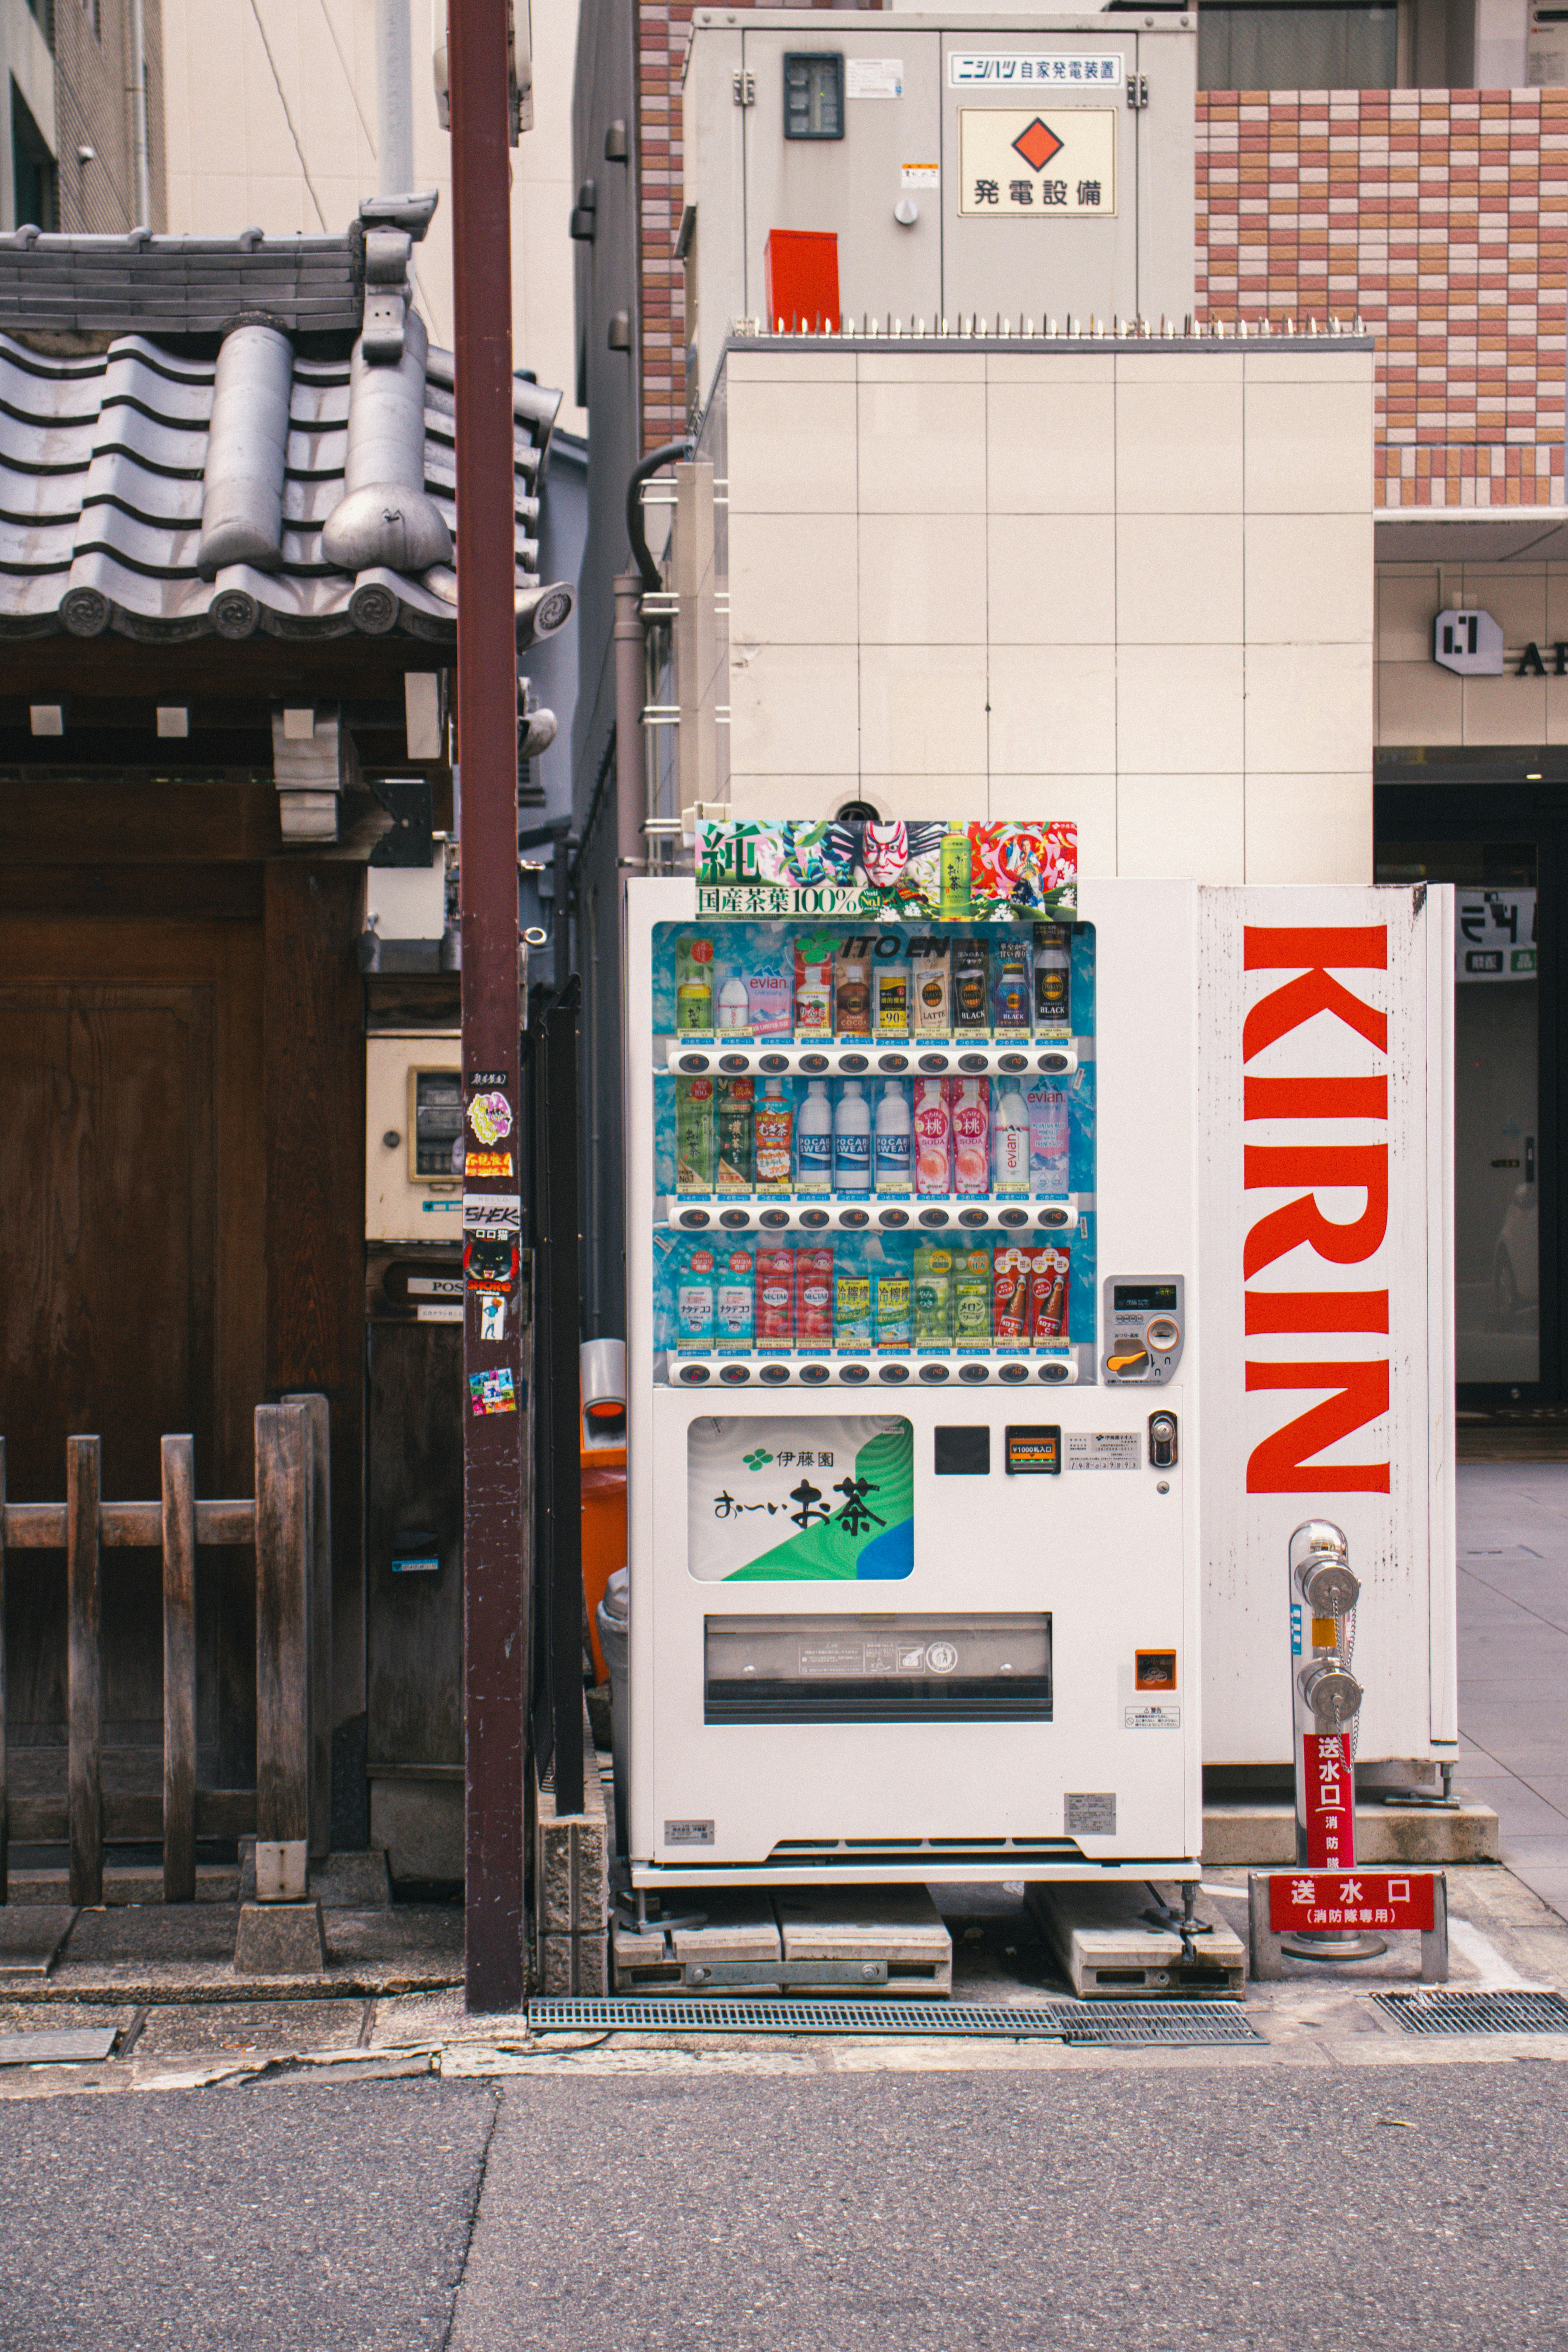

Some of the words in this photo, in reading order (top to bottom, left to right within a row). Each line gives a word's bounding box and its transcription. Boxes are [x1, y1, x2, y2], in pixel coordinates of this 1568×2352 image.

[959, 61, 1016, 78] ニシハツ
[1022, 61, 1114, 79] 自家発電装置
[975, 179, 1102, 205] 発電設備
[699, 823, 762, 884] 純
[947, 864, 962, 891] お茶
[699, 888, 857, 913] 国産茶葉100%
[861, 896, 880, 907] No.1
[842, 936, 900, 958] ITO
[905, 936, 951, 958] EN
[750, 976, 786, 989] evian
[800, 1007, 826, 1017] りんご
[886, 1012, 900, 1023] 90
[923, 1010, 945, 1020] LATTE
[962, 1010, 985, 1019] BLACK
[1027, 1091, 1063, 1103] evian
[758, 1122, 788, 1136] むぎ茶
[925, 1118, 942, 1135] 桃
[963, 1117, 980, 1134] 桃
[1006, 1133, 1016, 1168] evian
[1243, 924, 1390, 1494] KIRIN
[919, 1290, 933, 1299] やみ
[919, 1299, 933, 1308] つき
[960, 1302, 984, 1312] メロン
[777, 1451, 834, 1468] 伊藤園
[1318, 1737, 1340, 1806] 送水口
[1291, 1878, 1410, 1905] 送水口
